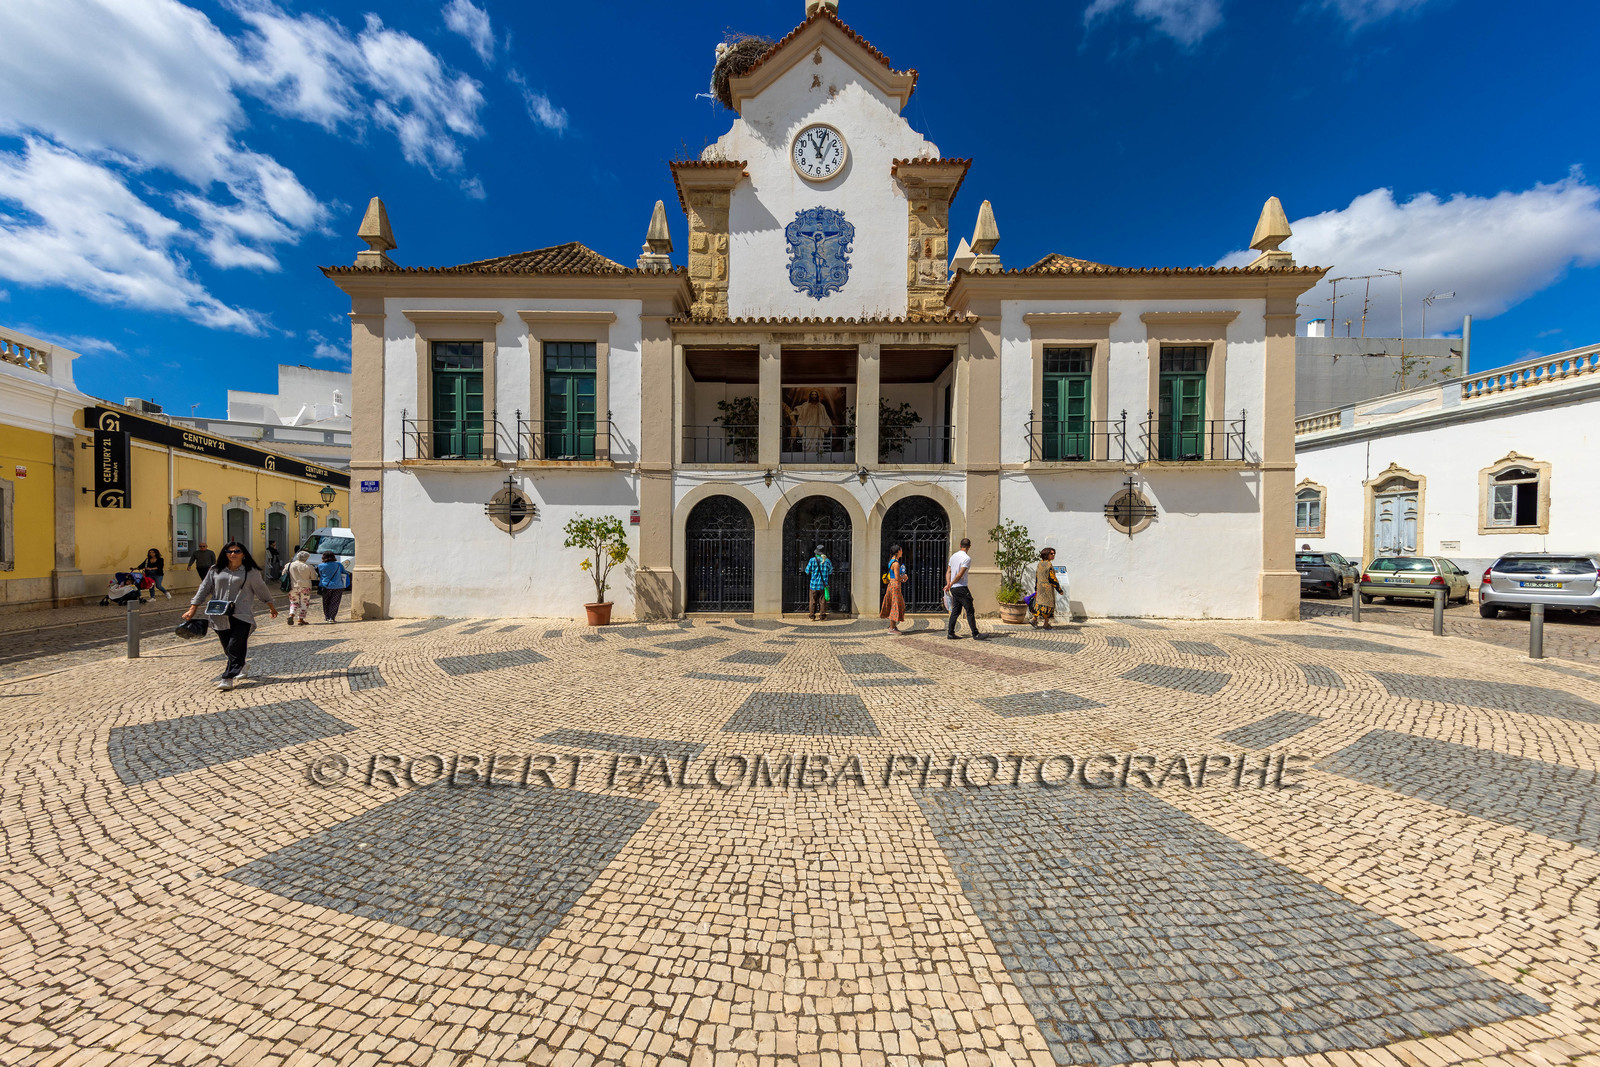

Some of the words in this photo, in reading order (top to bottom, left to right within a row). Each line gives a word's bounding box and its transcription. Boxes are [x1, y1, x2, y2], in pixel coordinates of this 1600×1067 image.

[807, 133, 813, 141] 11
[816, 130, 823, 138] 12
[800, 140, 807, 148] 10
[832, 139, 837, 147] 2
[816, 166, 821, 174] 6
[103, 438, 112, 446] 21
[183, 432, 218, 448] CENTURY
[218, 442, 226, 450] 21
[103, 448, 112, 482] CENTURY
[306, 466, 324, 476] CENTURY
